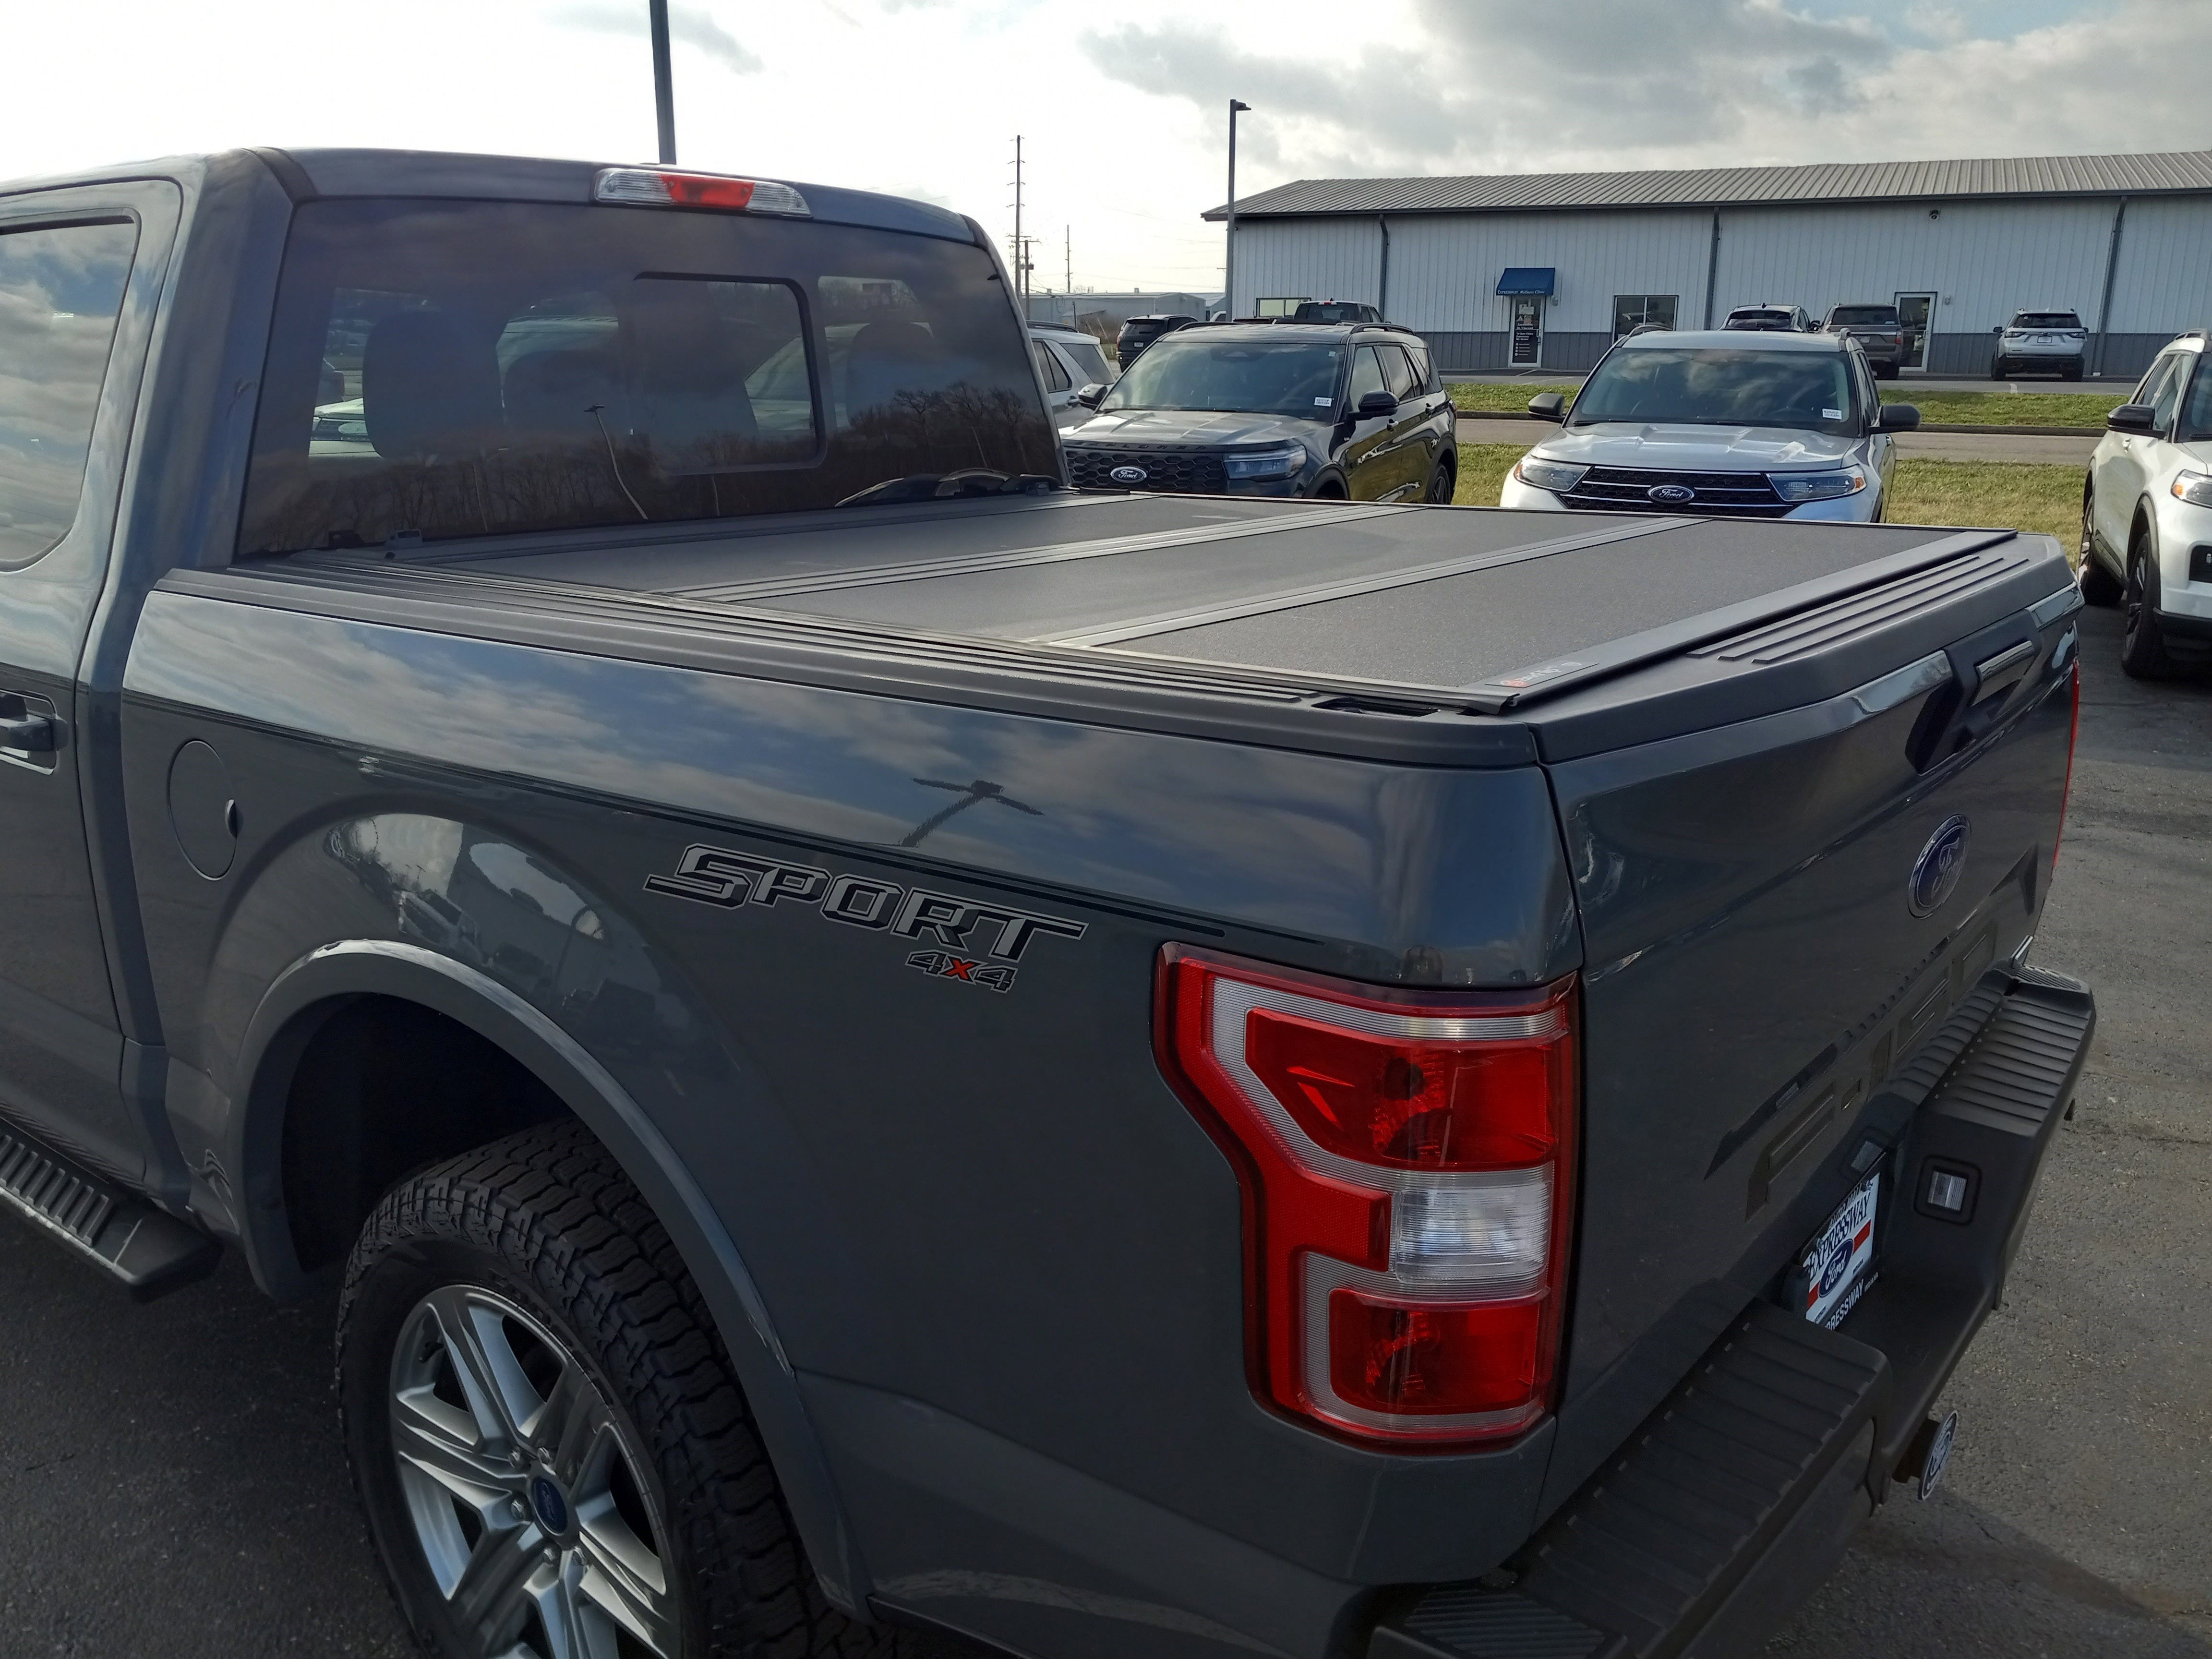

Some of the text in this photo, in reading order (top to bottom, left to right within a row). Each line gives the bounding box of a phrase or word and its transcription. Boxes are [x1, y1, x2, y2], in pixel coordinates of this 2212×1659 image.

[1118, 470, 1138, 479] Ford
[1659, 489, 1684, 499] Ford
[643, 843, 1089, 962] SPORT
[1809, 1191, 1871, 1280] EXPRESSWAY
[1825, 1250, 1848, 1290] Ford
[1825, 1278, 1863, 1331] PRESSWAY
